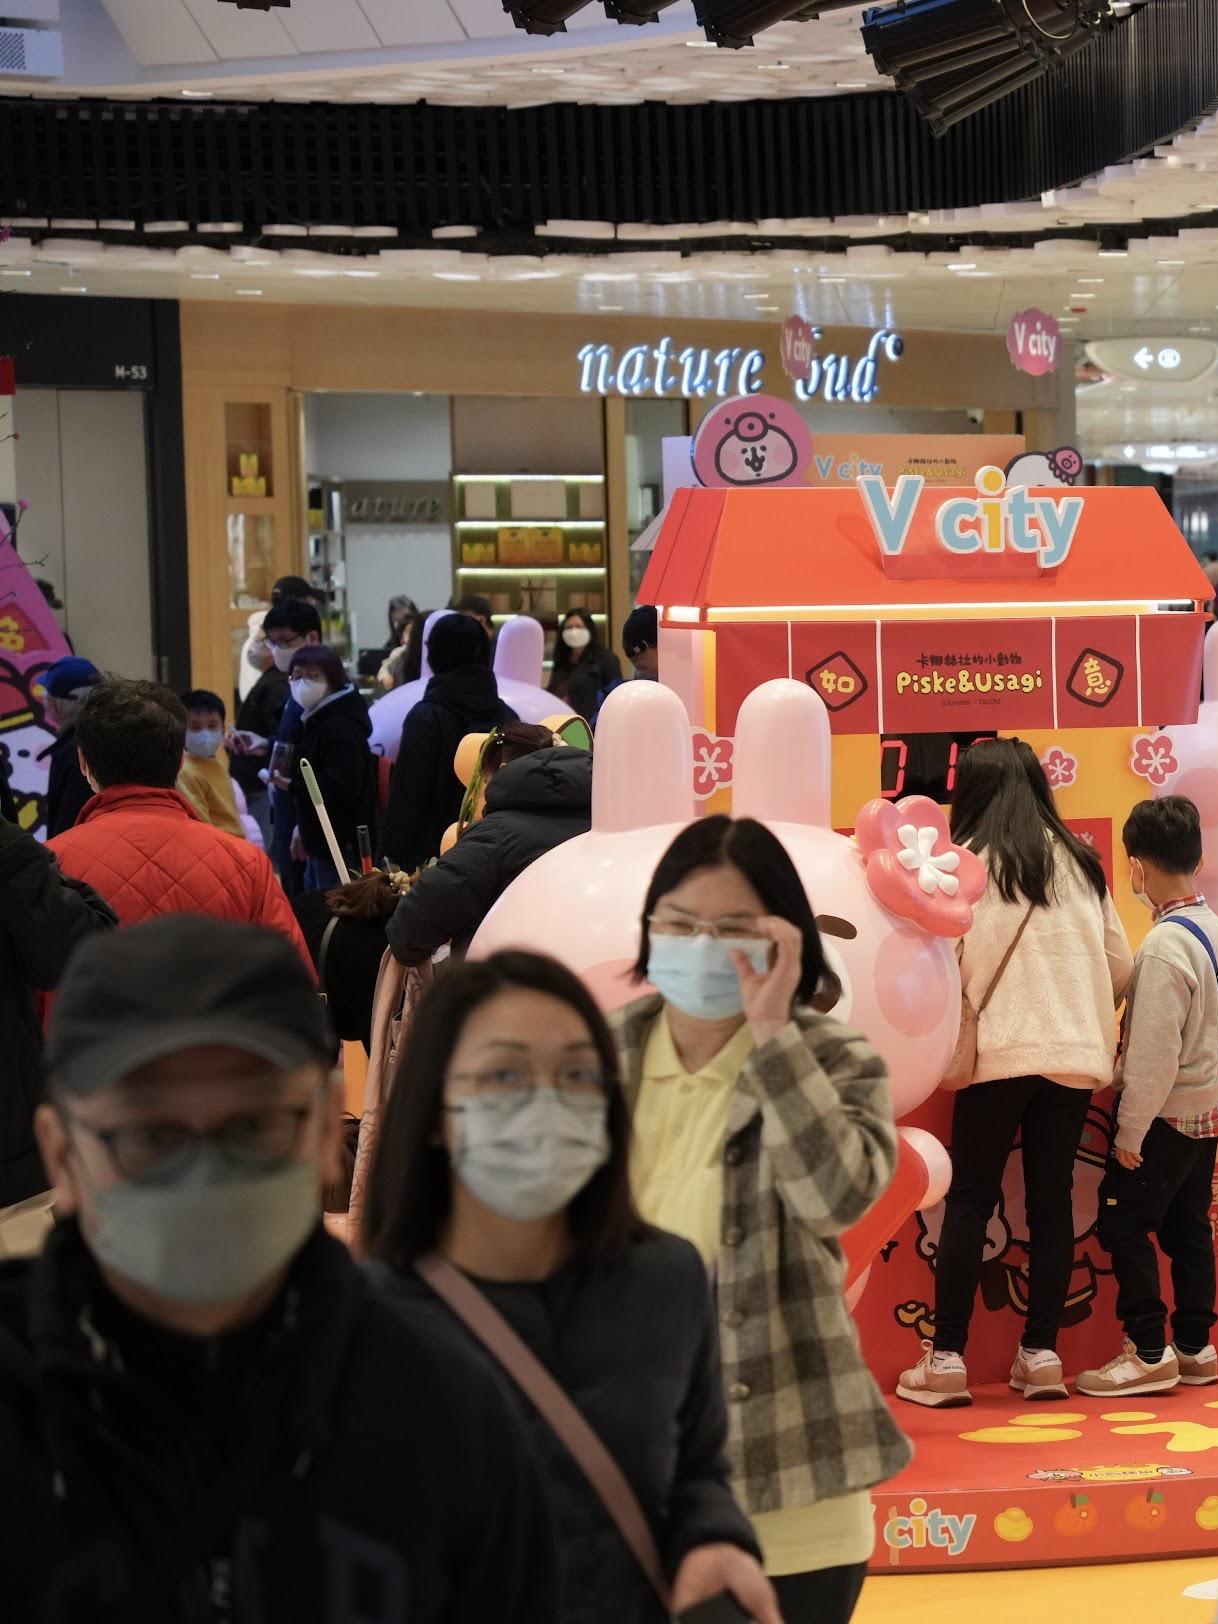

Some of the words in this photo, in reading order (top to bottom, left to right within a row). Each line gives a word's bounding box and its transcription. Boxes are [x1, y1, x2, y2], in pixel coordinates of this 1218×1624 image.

[1014, 322, 1026, 354] V
[1028, 321, 1057, 362] city
[577, 337, 765, 396] nature
[815, 455, 834, 480] V
[856, 474, 925, 555] V
[934, 465, 1084, 568] city
[819, 669, 855, 694] 如
[896, 669, 1043, 694] Piske&Usagi
[1083, 657, 1112, 696] 意
[884, 1498, 977, 1556] city
